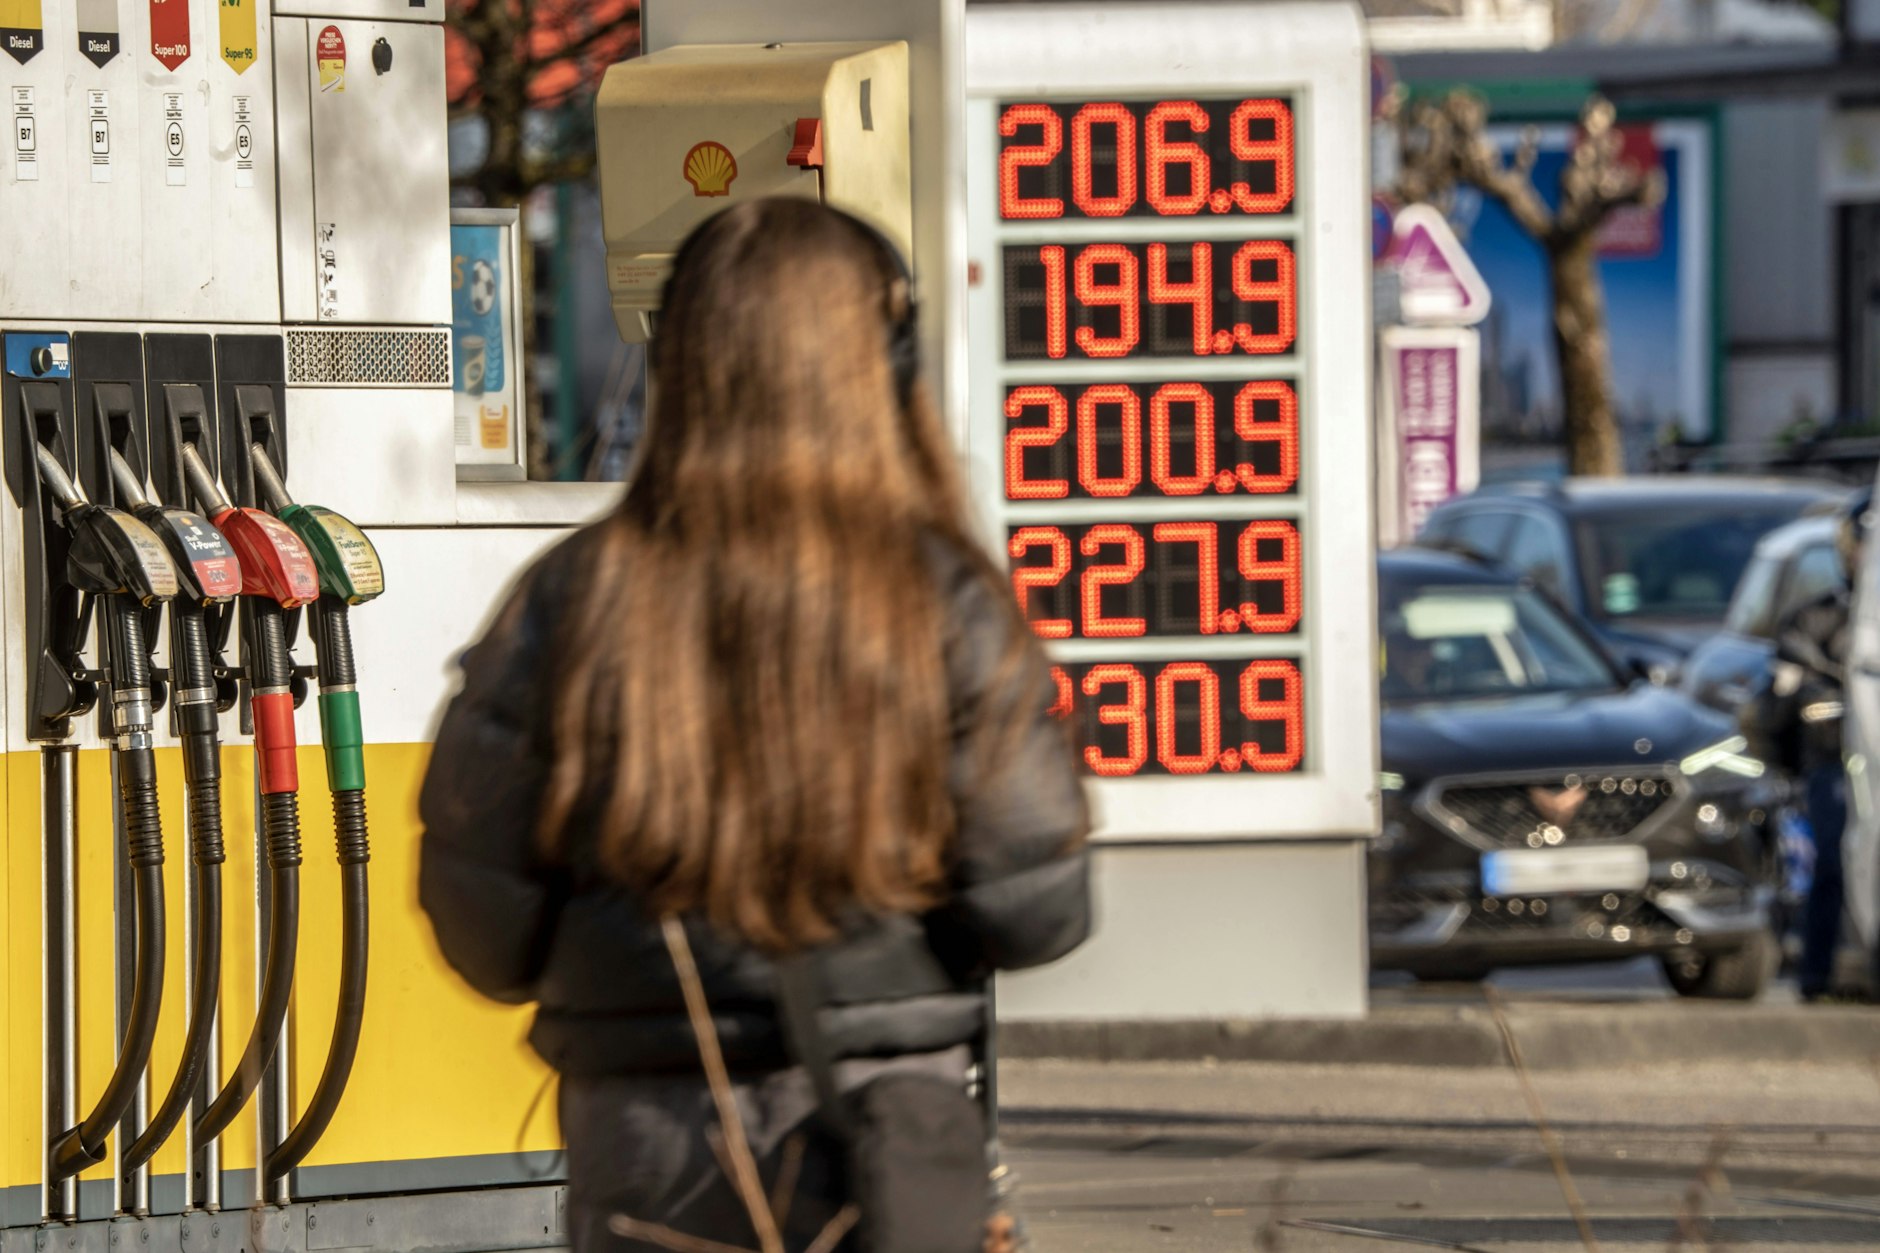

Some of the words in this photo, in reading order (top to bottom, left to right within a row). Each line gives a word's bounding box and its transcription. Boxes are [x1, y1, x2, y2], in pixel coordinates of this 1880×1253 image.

[9, 36, 34, 49] Diesel
[88, 40, 111, 53] Diesel
[154, 43, 175, 58] Super
[175, 44, 187, 56] 100
[225, 47, 244, 61] Super
[244, 48, 253, 60] 95
[20, 128, 31, 140] B7
[95, 131, 105, 143] B7
[170, 133, 180, 145] E5
[239, 135, 249, 148] E5
[998, 98, 1294, 218] 206.9
[1041, 240, 1296, 358] 194.9
[1004, 381, 1298, 498] 200.9
[189, 541, 222, 551] V-Power
[1008, 521, 1303, 637] 227.9
